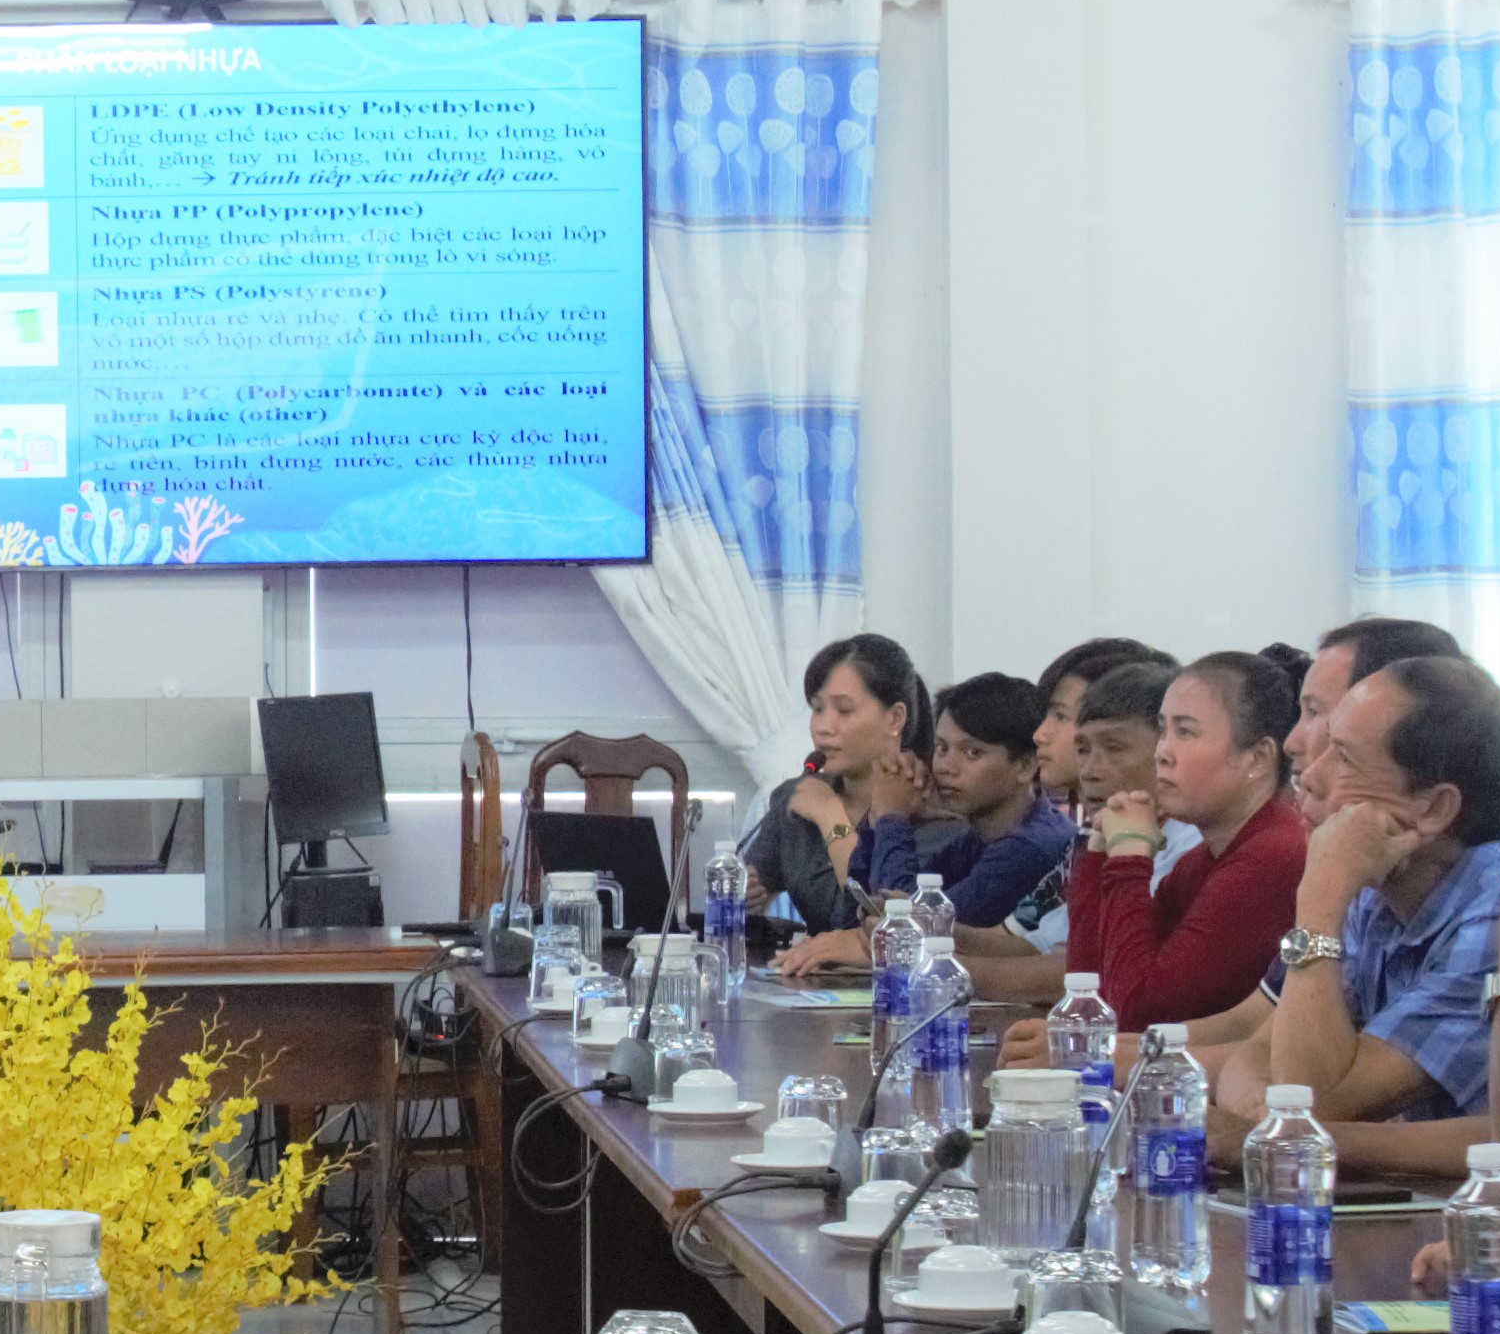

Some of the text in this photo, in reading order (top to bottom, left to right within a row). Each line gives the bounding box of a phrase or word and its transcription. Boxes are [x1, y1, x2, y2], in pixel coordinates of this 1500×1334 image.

[180, 46, 262, 77] NHỰA
[90, 99, 535, 119] LDPE (Low Density Polyethylene)
[90, 126, 142, 147] Ứng
[150, 128, 208, 147] dụng
[216, 124, 255, 143] chế
[265, 130, 298, 145] tạo
[306, 126, 345, 141] các
[354, 125, 394, 144] loại
[404, 125, 458, 142] chai,
[467, 125, 489, 142] lọ
[564, 123, 606, 139] hóa
[90, 148, 144, 168] chất,
[159, 151, 214, 169] găng
[229, 151, 261, 167] tay
[276, 148, 298, 164] ni
[313, 148, 370, 165] lông,
[385, 147, 413, 163] túi
[500, 145, 563, 164] hàng,
[230, 170, 300, 186] Tránh
[308, 166, 351, 188] tiếp
[357, 168, 401, 184] xúc
[409, 167, 470, 187] nhiệt
[512, 170, 559, 183] cao.
[92, 203, 423, 223] Nhựa PP (Polypropylene)
[92, 232, 142, 249] Hộp
[220, 230, 271, 248] thực
[410, 227, 453, 244] biệt
[463, 226, 501, 242] các
[511, 225, 552, 244] loại
[563, 225, 607, 244] hộp
[92, 253, 142, 270] thực
[223, 252, 250, 267] có
[301, 251, 359, 268] dùng
[367, 252, 428, 267] trong
[466, 248, 487, 264] vi
[496, 249, 557, 266] sóng.
[92, 283, 387, 304] Nhựa PS (Polystyrene)
[93, 312, 146, 330] Loại
[157, 312, 216, 329] nhựa
[260, 310, 286, 325] và
[358, 308, 393, 323] Có
[450, 307, 488, 322] tìm
[500, 303, 549, 324] thấy
[561, 306, 607, 321] trên
[130, 333, 176, 349] một
[217, 332, 261, 349] hộp
[374, 330, 401, 345] ăn
[410, 328, 490, 345] nhanh,
[498, 324, 538, 343] cốc
[93, 380, 608, 404] Nhựa PC (Polycarbonate) và các loại
[94, 407, 327, 428] nhựa khác (other)
[95, 434, 160, 452] Nhựa
[171, 433, 206, 448] PC
[217, 433, 236, 447] là
[246, 432, 287, 448] các
[297, 431, 340, 449] loại
[351, 431, 410, 449] nhựa
[420, 433, 461, 448] cực
[564, 427, 608, 445] hại,
[194, 455, 247, 470] bình
[415, 452, 455, 467] các
[468, 450, 536, 469] thùng
[549, 450, 608, 468] nhựa
[164, 477, 208, 492] hóa
[215, 474, 272, 492] chất.
